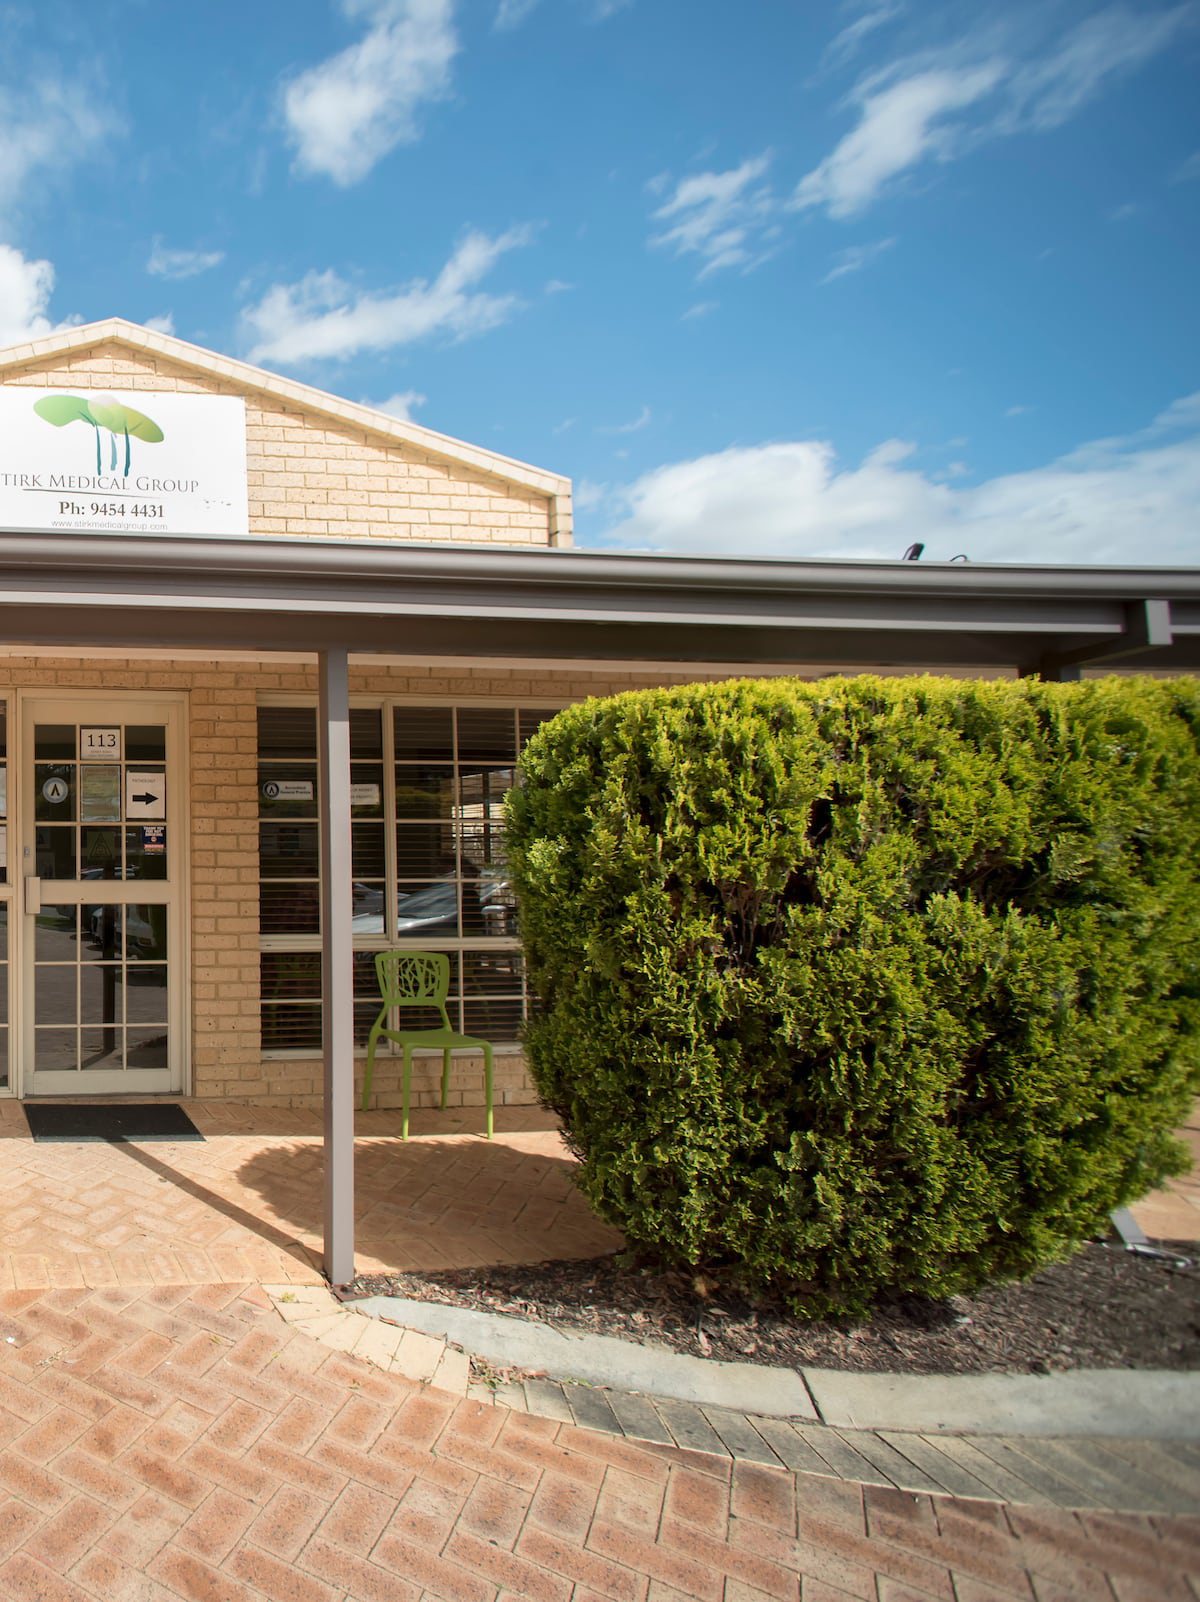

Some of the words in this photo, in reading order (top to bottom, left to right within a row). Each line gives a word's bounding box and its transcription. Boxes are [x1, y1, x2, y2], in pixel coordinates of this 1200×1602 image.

[49, 474, 130, 491] MEDICAL
[136, 476, 199, 493] GROUP
[59, 501, 85, 516] Ph:
[90, 501, 126, 517] 9454
[130, 503, 164, 518] 4431
[88, 734, 116, 747] 113
